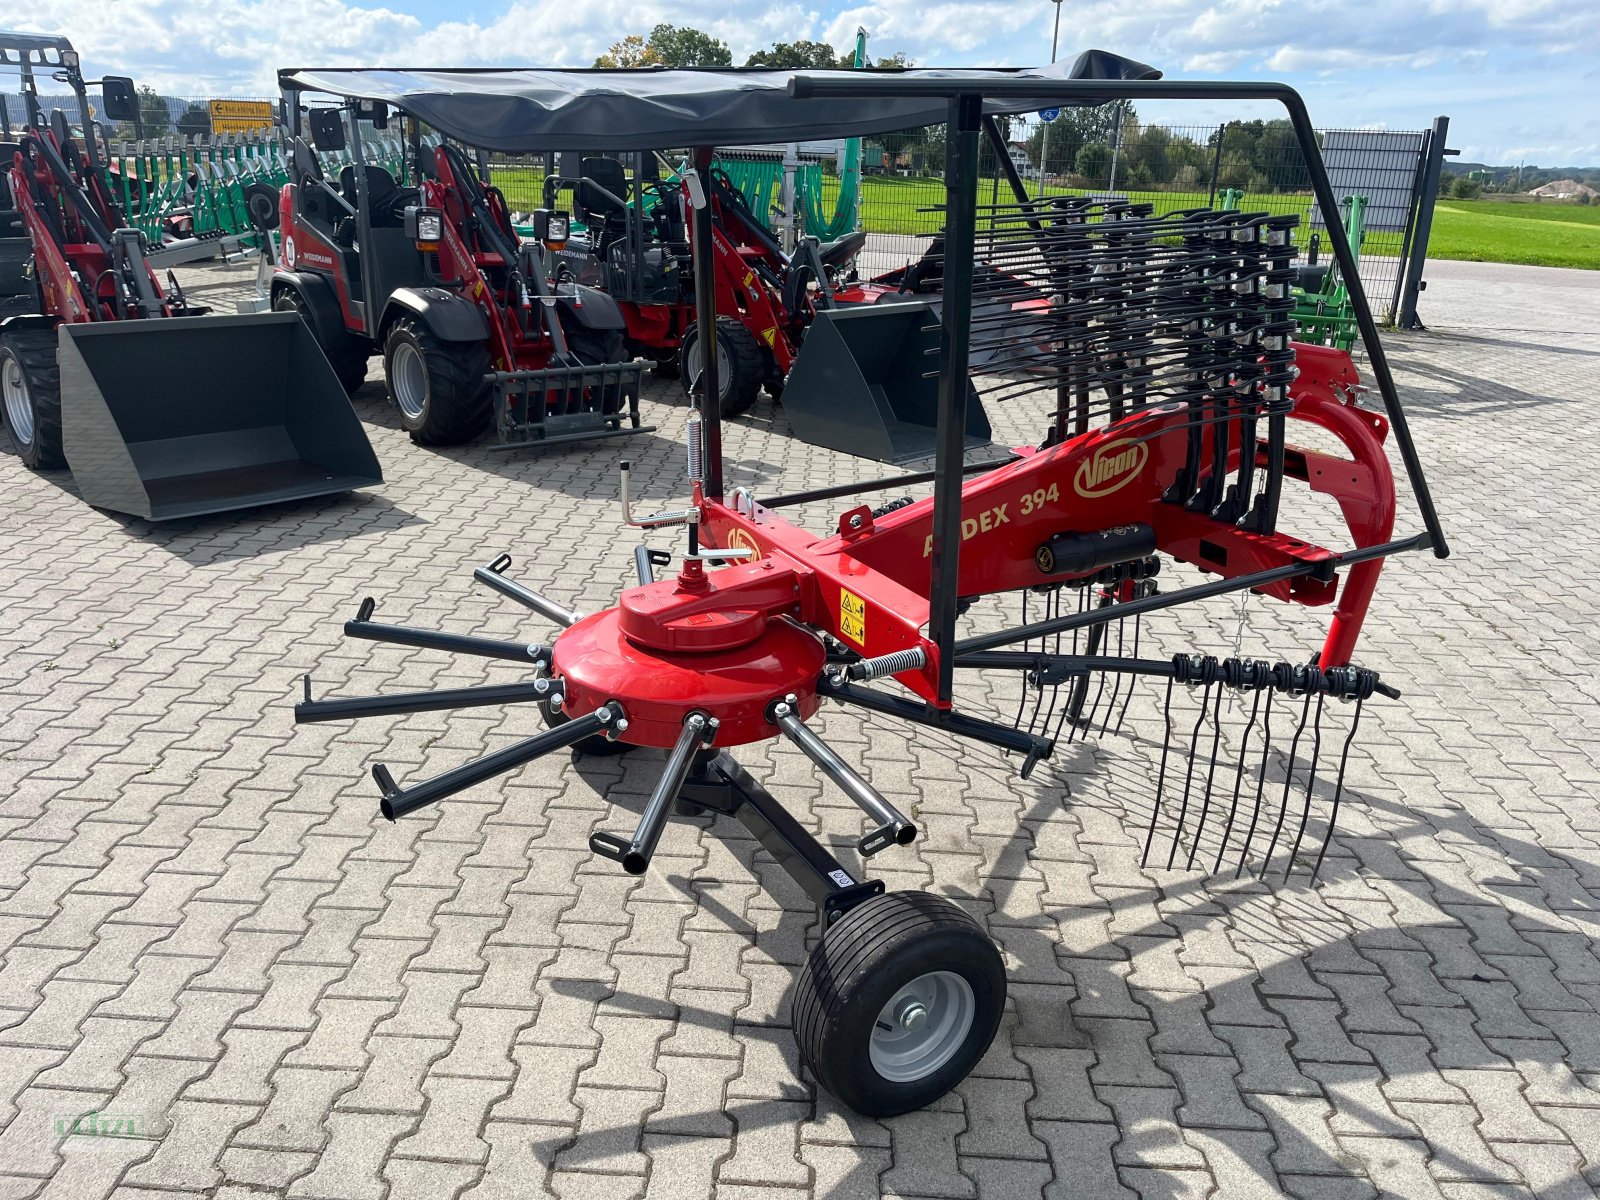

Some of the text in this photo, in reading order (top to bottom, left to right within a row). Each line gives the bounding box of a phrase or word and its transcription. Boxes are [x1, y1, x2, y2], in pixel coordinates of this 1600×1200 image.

[303, 252, 333, 265] WEIDEMANN
[555, 250, 588, 260] WEIDEMANN
[1082, 446, 1140, 490] Vicon
[922, 482, 1060, 558] ADEX 394
